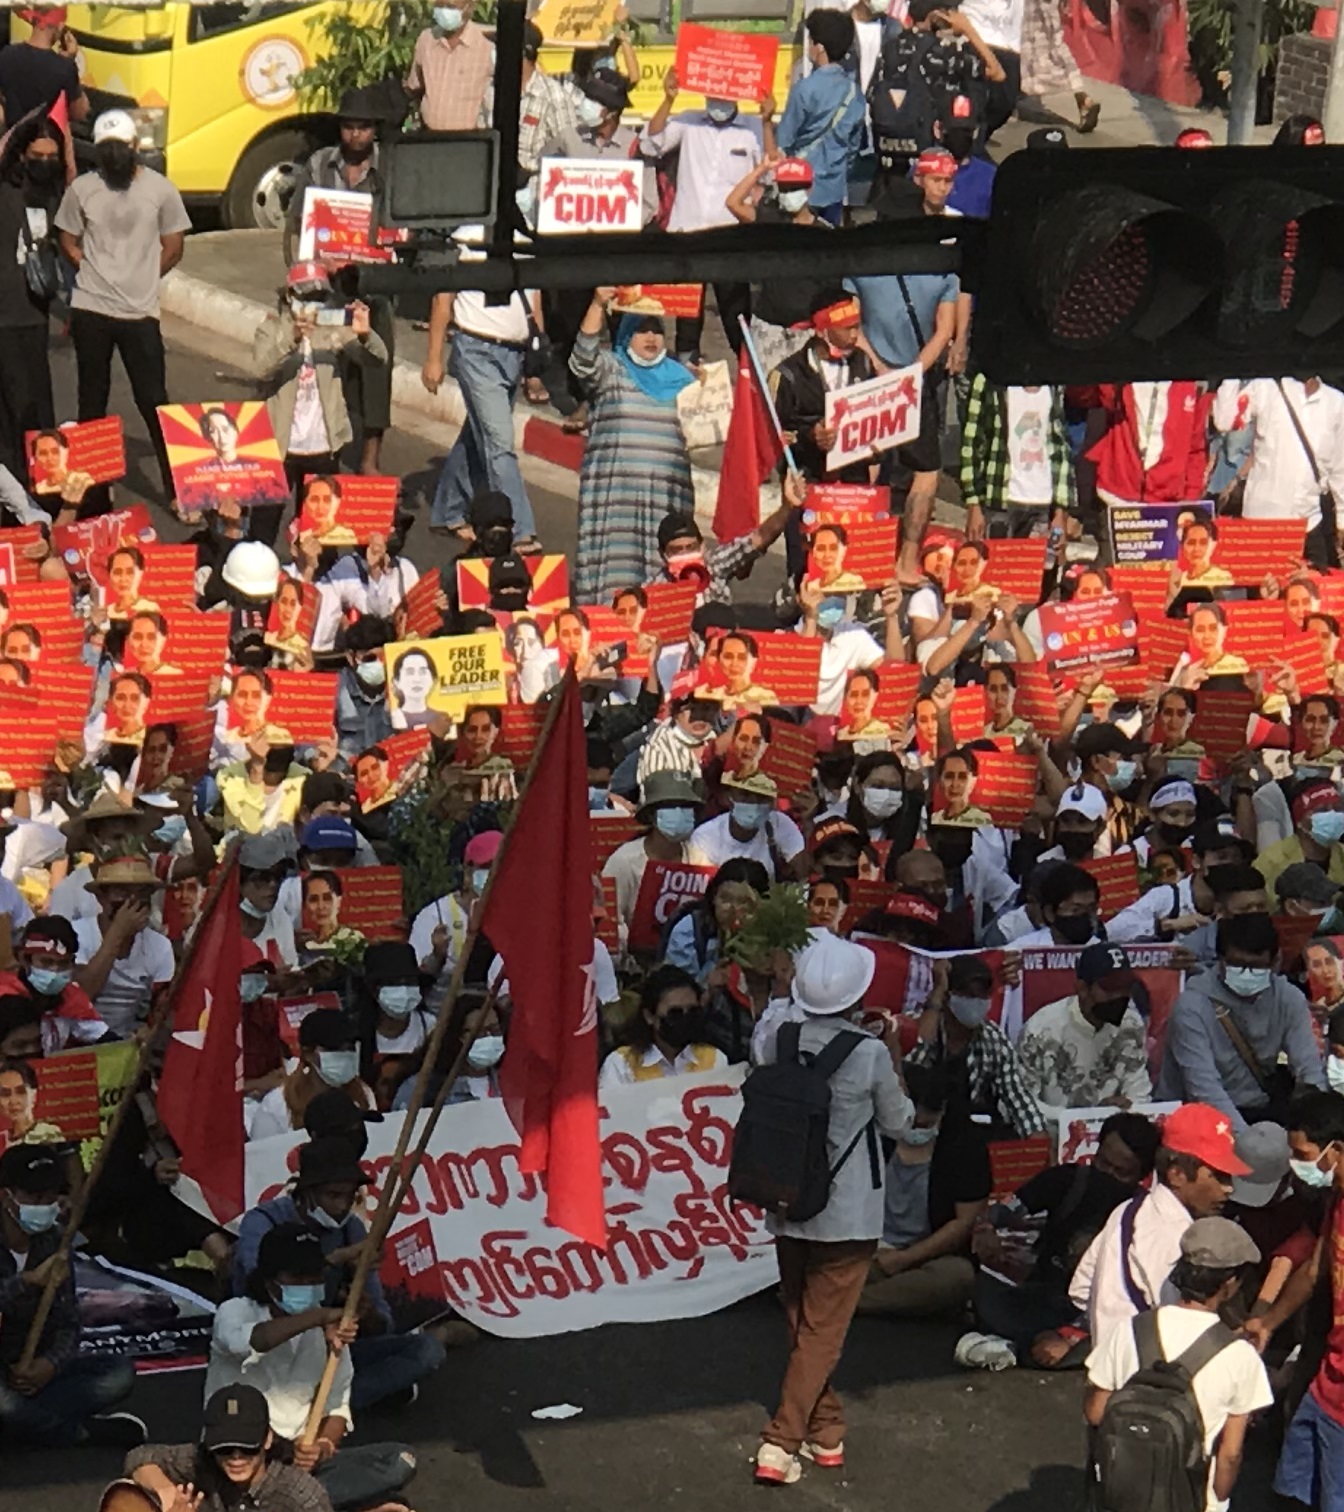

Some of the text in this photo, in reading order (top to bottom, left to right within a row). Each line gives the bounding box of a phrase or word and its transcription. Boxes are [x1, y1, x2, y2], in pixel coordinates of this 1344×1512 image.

[555, 194, 626, 225] CDM
[841, 404, 907, 454] CDM
[1113, 511, 1141, 520] SAVE
[1087, 628, 1098, 641] &
[449, 644, 487, 660] FREE
[452, 658, 485, 673] OUR
[440, 670, 500, 687] LEADER
[1023, 951, 1044, 968] WE
